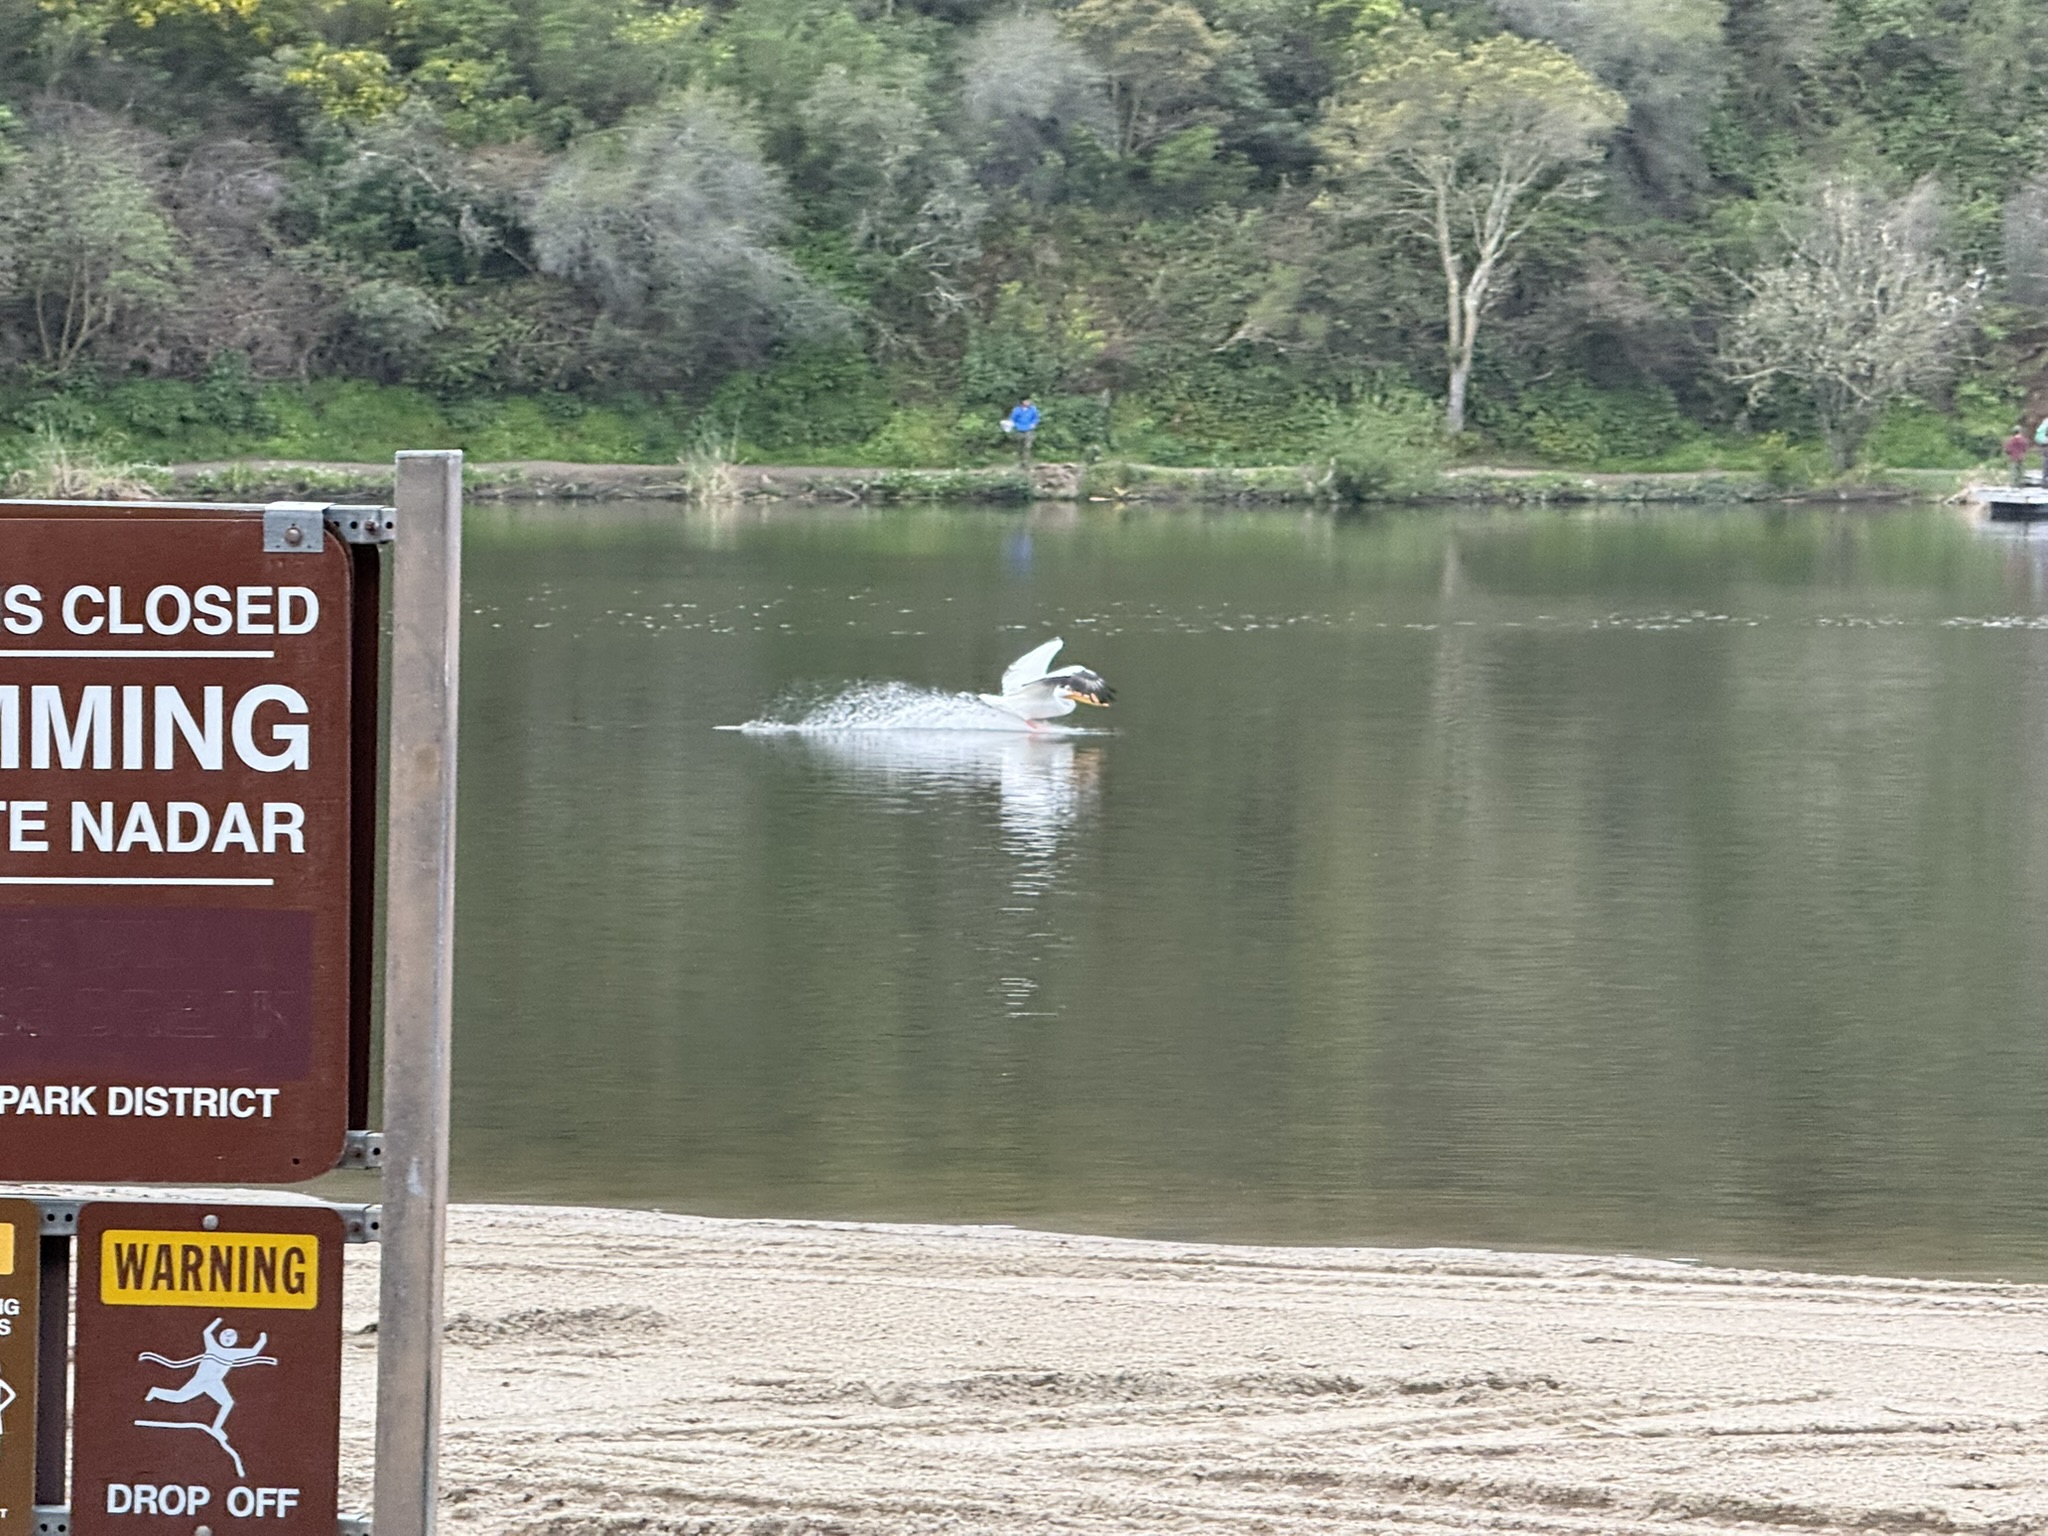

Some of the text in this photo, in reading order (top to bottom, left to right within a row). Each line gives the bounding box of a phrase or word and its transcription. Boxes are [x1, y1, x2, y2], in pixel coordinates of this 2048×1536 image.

[4, 585, 319, 635] S CLOSED
[0, 684, 309, 772] MING
[0, 801, 305, 853] E NADAR
[0, 1086, 279, 1117] PARK DISTRICT
[115, 1243, 305, 1294] WARNING
[0, 1299, 19, 1315] G
[108, 1484, 299, 1517] DROP OFF
